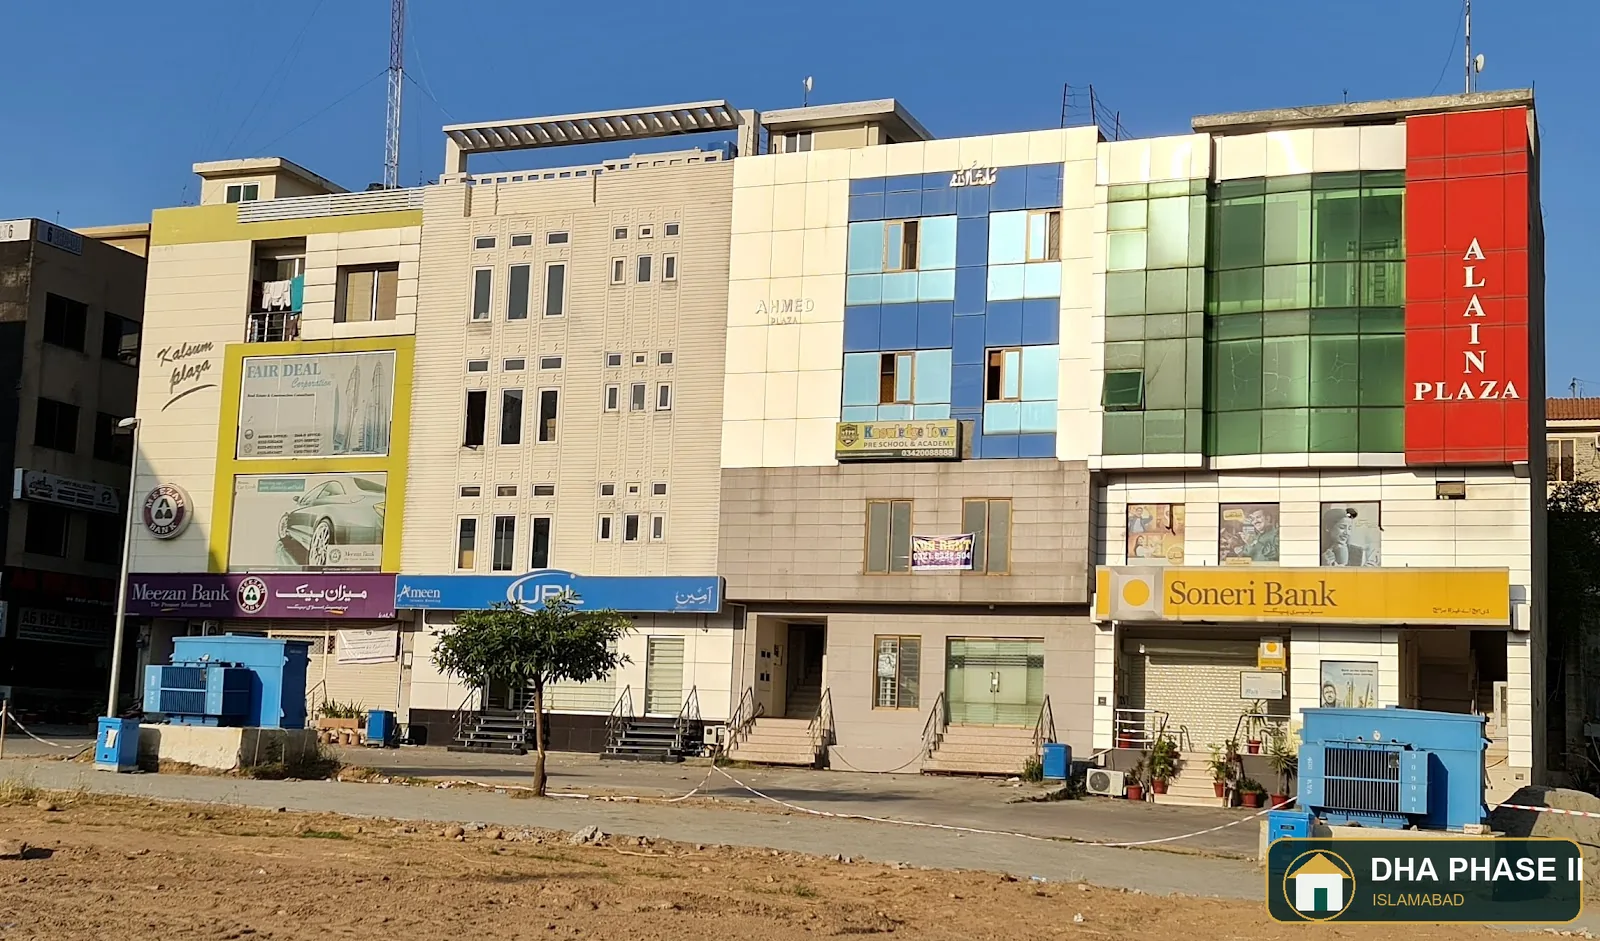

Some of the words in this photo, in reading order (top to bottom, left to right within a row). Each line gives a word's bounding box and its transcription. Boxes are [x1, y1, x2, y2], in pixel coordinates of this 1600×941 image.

[755, 298, 815, 314] AHMED
[770, 316, 798, 325] PLAZA
[157, 341, 214, 367] Kalsum
[170, 359, 211, 394] plaza
[247, 364, 279, 378] FAIR
[282, 363, 321, 377] DEAL
[291, 377, 332, 390] Corporation
[1413, 380, 1520, 401] PLAZA
[864, 424, 924, 440] Knowledge
[879, 440, 909, 448] SCHOOL
[145, 487, 184, 508] MEEZAN
[150, 522, 177, 534] BANK
[132, 583, 187, 600] Meezan
[192, 583, 230, 600] Bank
[240, 579, 265, 593] MEEZAN
[275, 583, 324, 602] بینک
[325, 584, 368, 602] میزان
[397, 584, 441, 602] Ameen
[1169, 580, 1256, 606] Soneri
[1264, 580, 1338, 606] Bank
[241, 603, 260, 611] BANK
[40, 612, 67, 628] REAL
